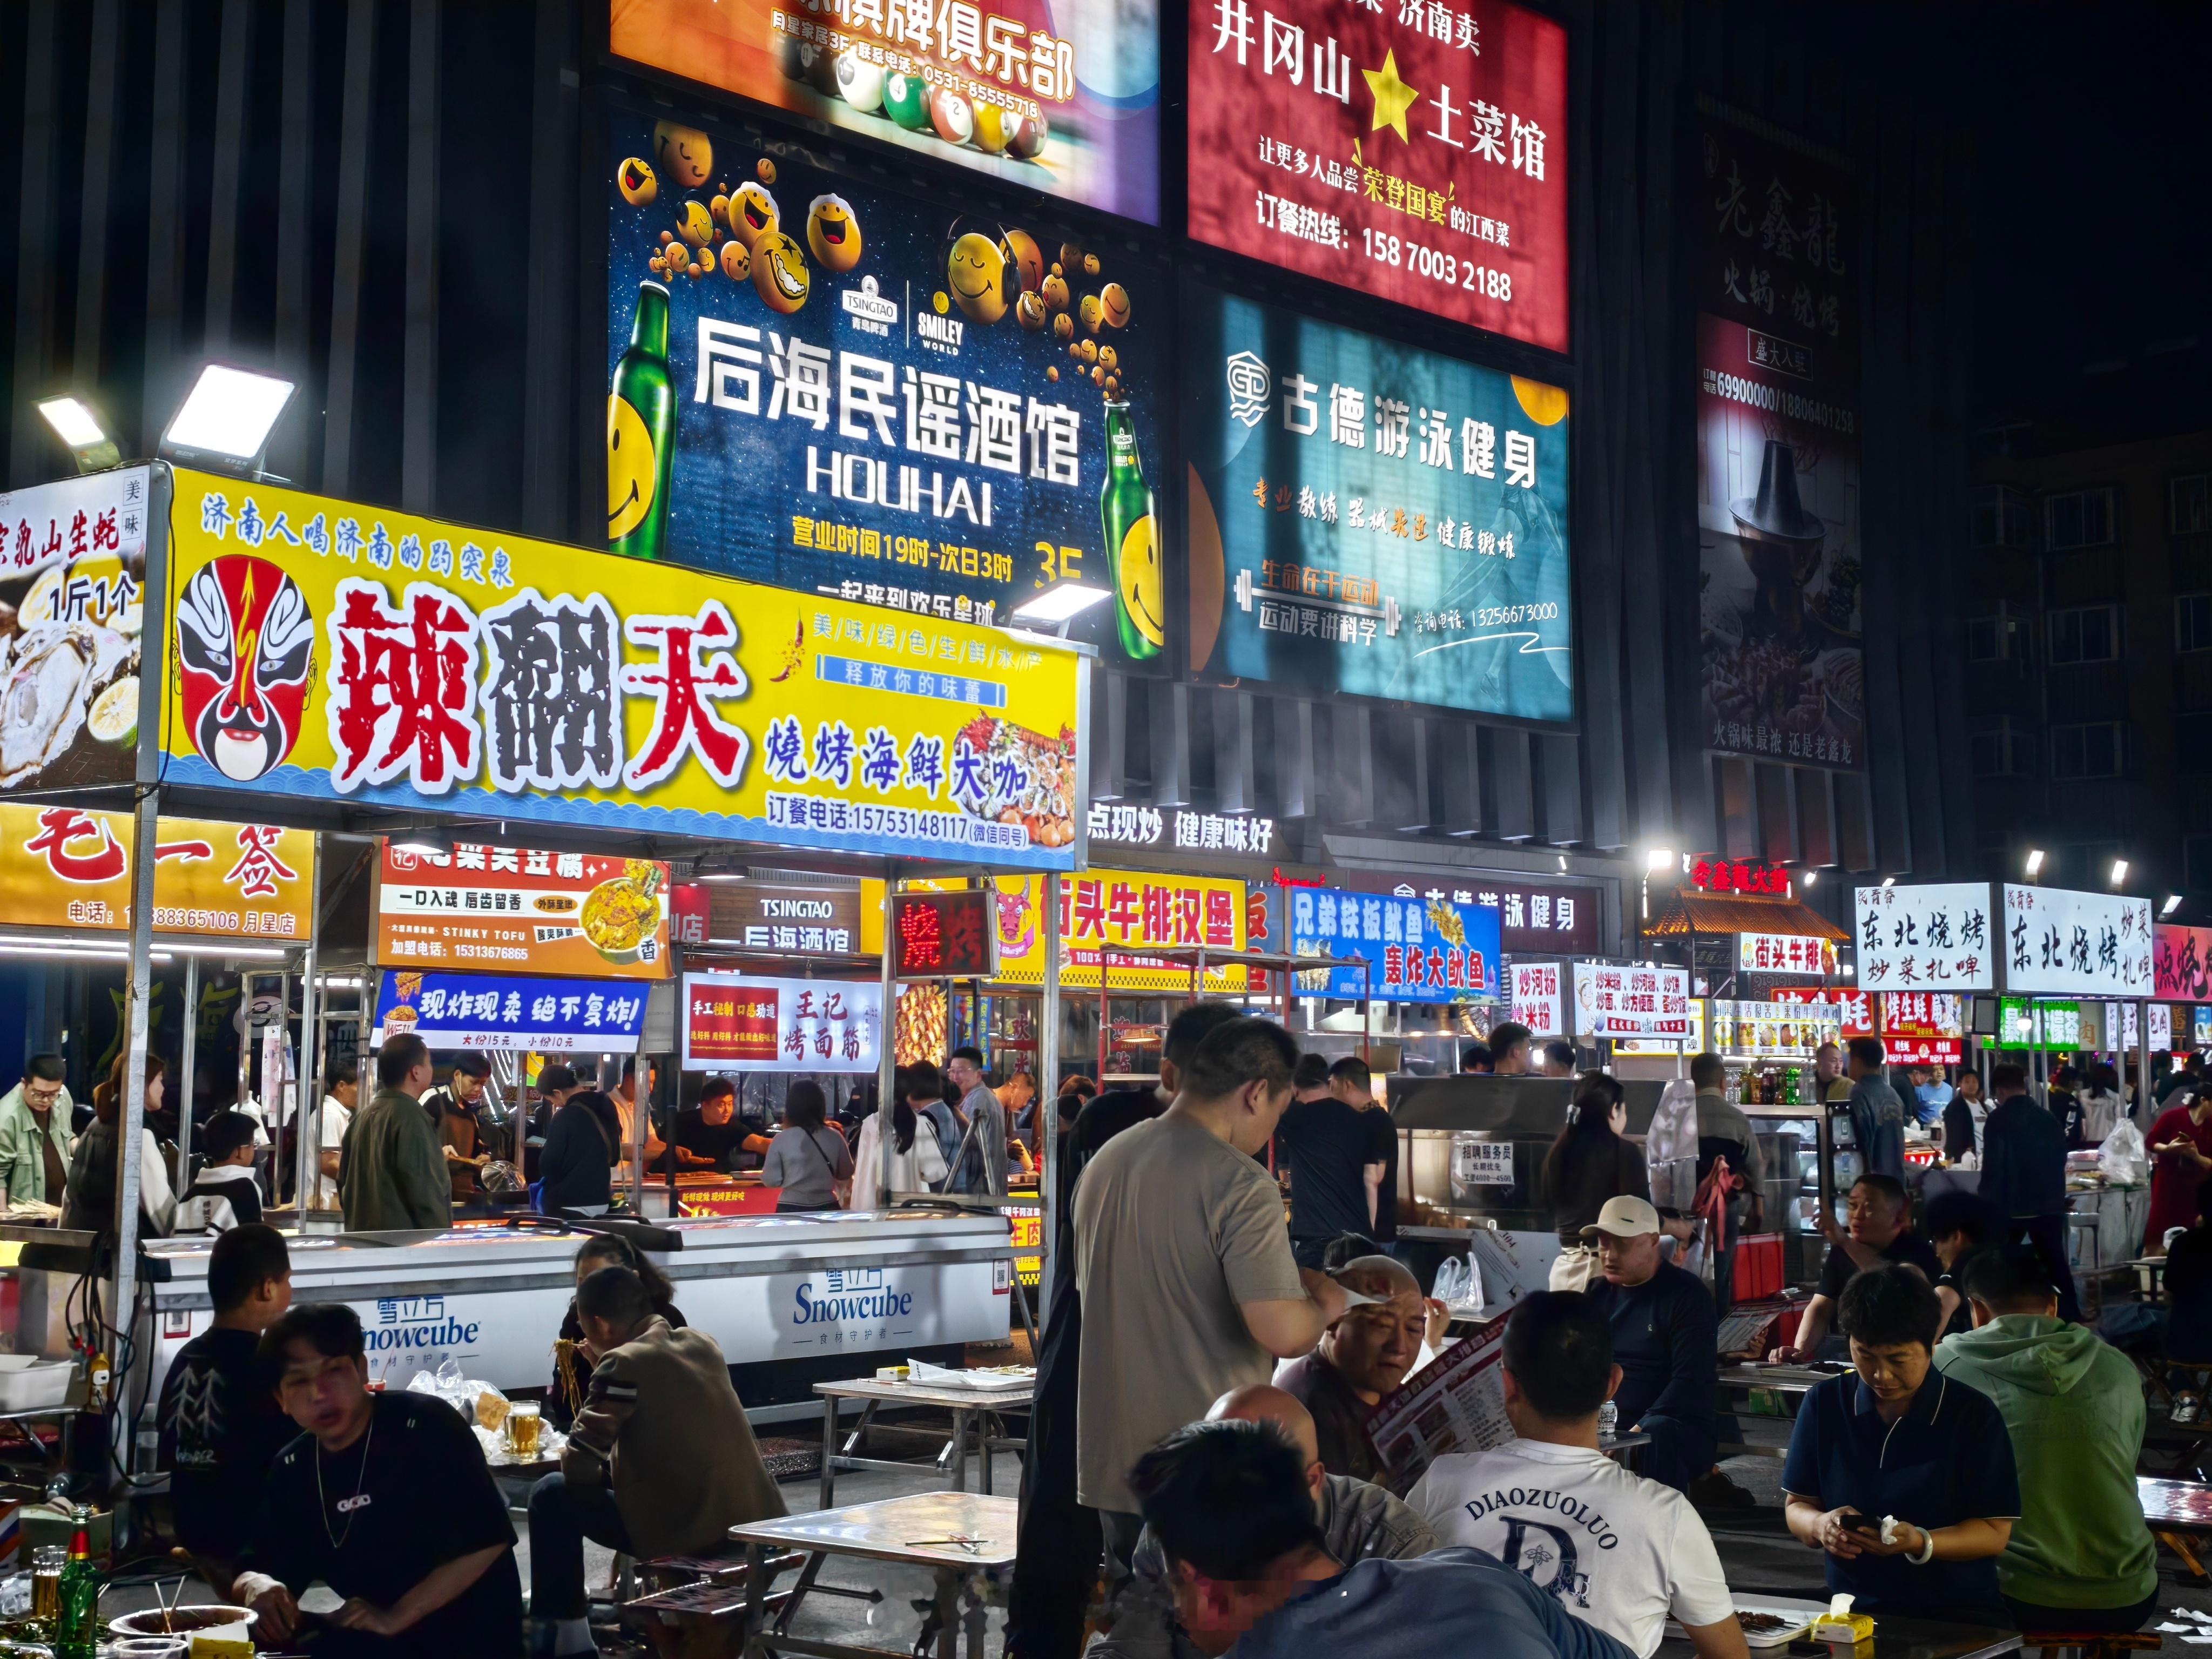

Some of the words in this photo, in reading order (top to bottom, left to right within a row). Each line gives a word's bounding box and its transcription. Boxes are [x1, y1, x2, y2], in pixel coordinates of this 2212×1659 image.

[1398, 0, 1481, 56] 济南卖
[771, 9, 849, 52] 月星家居3F
[924, 64, 1039, 118] 0531-85555718
[808, 0, 1075, 103] 棋牌俱乐部
[1212, 0, 1351, 105] 井冈山
[1427, 84, 1547, 181] 土菜馆
[1259, 134, 1359, 193] 让更多人品尝
[1363, 167, 1447, 226] 荣登国宴
[1451, 205, 1510, 247] 的江西菜
[1256, 190, 1349, 249] 订餐热线：
[1364, 227, 1400, 266] 158
[1406, 241, 1456, 285] 7003
[1462, 261, 1512, 302] 2188
[846, 295, 894, 318] TSINGTAO
[852, 316, 889, 337] 青岛啤酒
[918, 312, 963, 346] SMILEY
[922, 339, 959, 356] WORLD
[1756, 337, 1806, 373] 盛大入驻
[693, 316, 1081, 487] 后海民谣酒馆
[1283, 374, 1536, 489] 古德游泳健身
[806, 447, 992, 527] HOUHAI
[1253, 476, 1338, 524] 专业教练
[1348, 497, 1429, 541] 器械先进
[1437, 516, 1516, 560] 健康锻炼
[204, 494, 513, 587] 济南人喝济南的趵突泉
[49, 574, 137, 623] 1斤1个
[817, 580, 994, 627] 一起来到欢乐星球
[1262, 559, 1379, 606] 生命在于运动
[1259, 601, 1378, 646] 运动要讲科学
[1472, 602, 1558, 629] 13256673000
[845, 660, 980, 704] 释放你的味蕾
[1175, 811, 1273, 853] 健康味好
[400, 889, 458, 908] 一口入魂
[760, 899, 833, 919] TSINGTAO
[1295, 892, 1423, 943] 兄弟铁板鱿鱼
[125, 907, 238, 928] 188365106
[243, 912, 295, 934] 月星店
[443, 927, 488, 940] STINKY
[495, 930, 525, 941] TOFU
[670, 913, 703, 941] 店
[1862, 909, 1985, 951] 东北烧烤
[2121, 902, 2151, 945] 炒菜
[1384, 943, 1485, 989] 轰炸大鱿鱼
[1755, 937, 1819, 972] 街头牛排
[2011, 914, 2118, 980] 东北烧烤
[1519, 967, 1557, 997] 炒河粉
[1867, 954, 1981, 985] 炒菜扎啤
[419, 989, 521, 1023] 现炸现卖
[795, 989, 848, 1021] 王记
[784, 1025, 860, 1062] 烤面筋
[1462, 1145, 1511, 1159] 招聘服务员
[793, 1283, 913, 1325] Snowcube
[362, 1316, 479, 1351] nowcube
[820, 1327, 887, 1344] 食材守护者
[1465, 1487, 1618, 1550] DIAOZUOLUO
